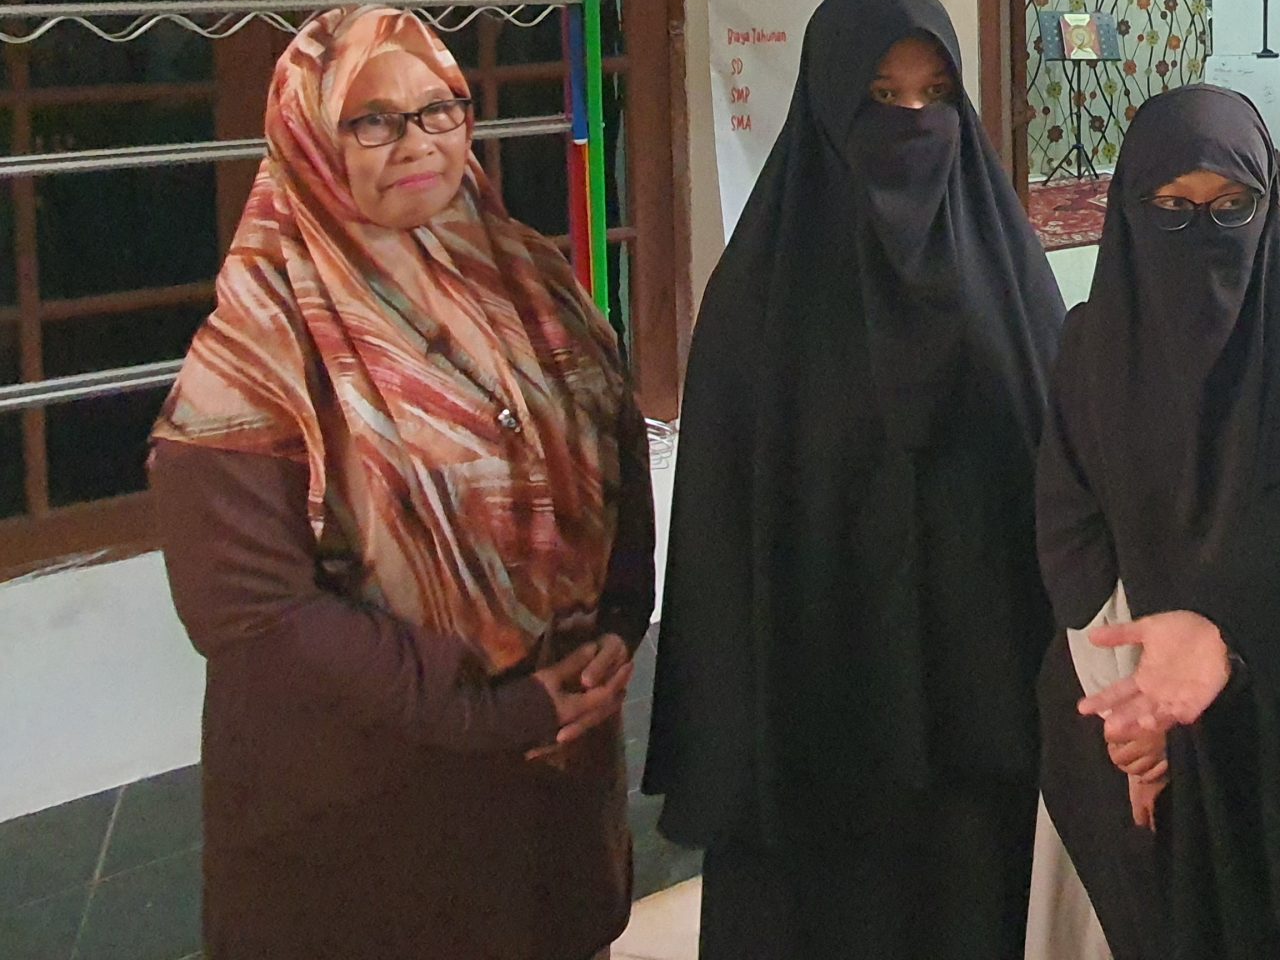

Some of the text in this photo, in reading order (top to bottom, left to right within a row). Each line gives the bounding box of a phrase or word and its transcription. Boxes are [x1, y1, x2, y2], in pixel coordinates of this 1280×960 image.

[730, 57, 743, 75] SD
[730, 86, 750, 104] SMP
[730, 115, 752, 132] SMA
